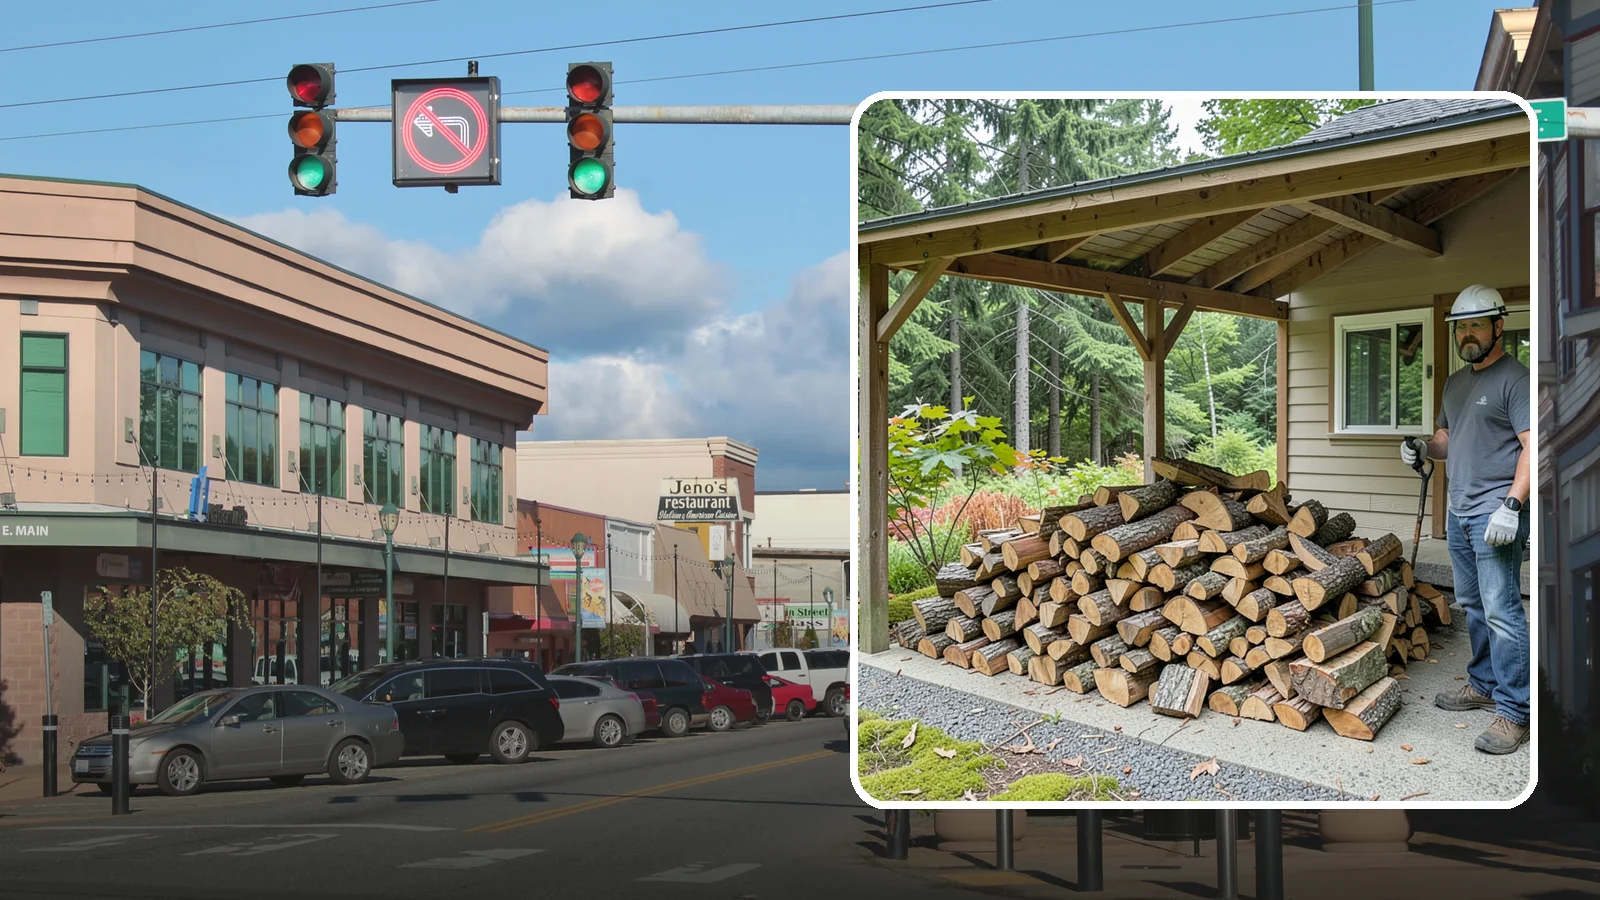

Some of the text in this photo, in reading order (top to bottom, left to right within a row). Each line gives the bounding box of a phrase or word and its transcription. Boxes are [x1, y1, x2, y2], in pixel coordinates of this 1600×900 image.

[669, 480, 727, 495] Jeno's
[665, 496, 731, 508] restaurant
[658, 509, 681, 520] Italian
[685, 509, 715, 520] American
[715, 509, 738, 519] Cuisine
[2, 525, 49, 536] E. MAIN
[797, 608, 828, 616] Street
